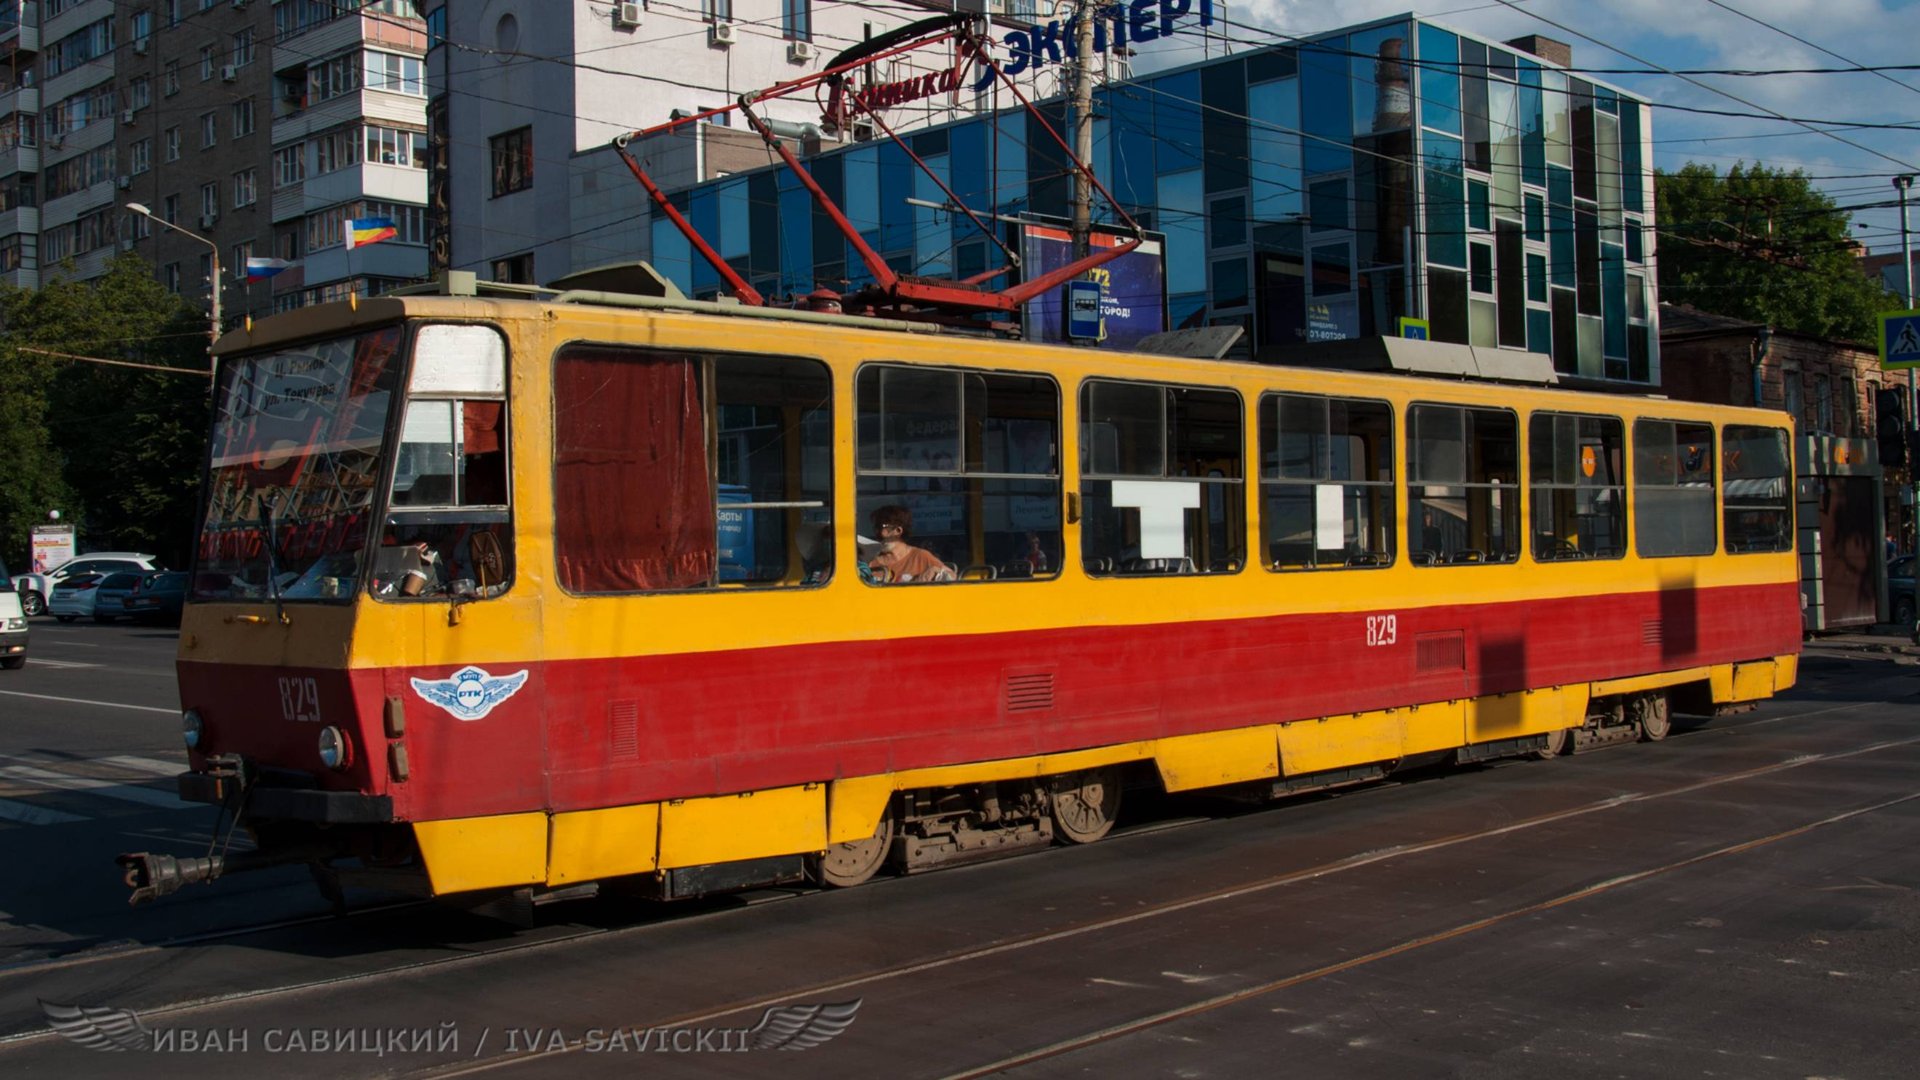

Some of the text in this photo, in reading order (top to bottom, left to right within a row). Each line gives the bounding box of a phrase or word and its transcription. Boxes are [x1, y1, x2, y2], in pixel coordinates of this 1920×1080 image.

[1366, 614, 1396, 646] 829
[278, 676, 321, 722] 829
[458, 689, 482, 698] РТК
